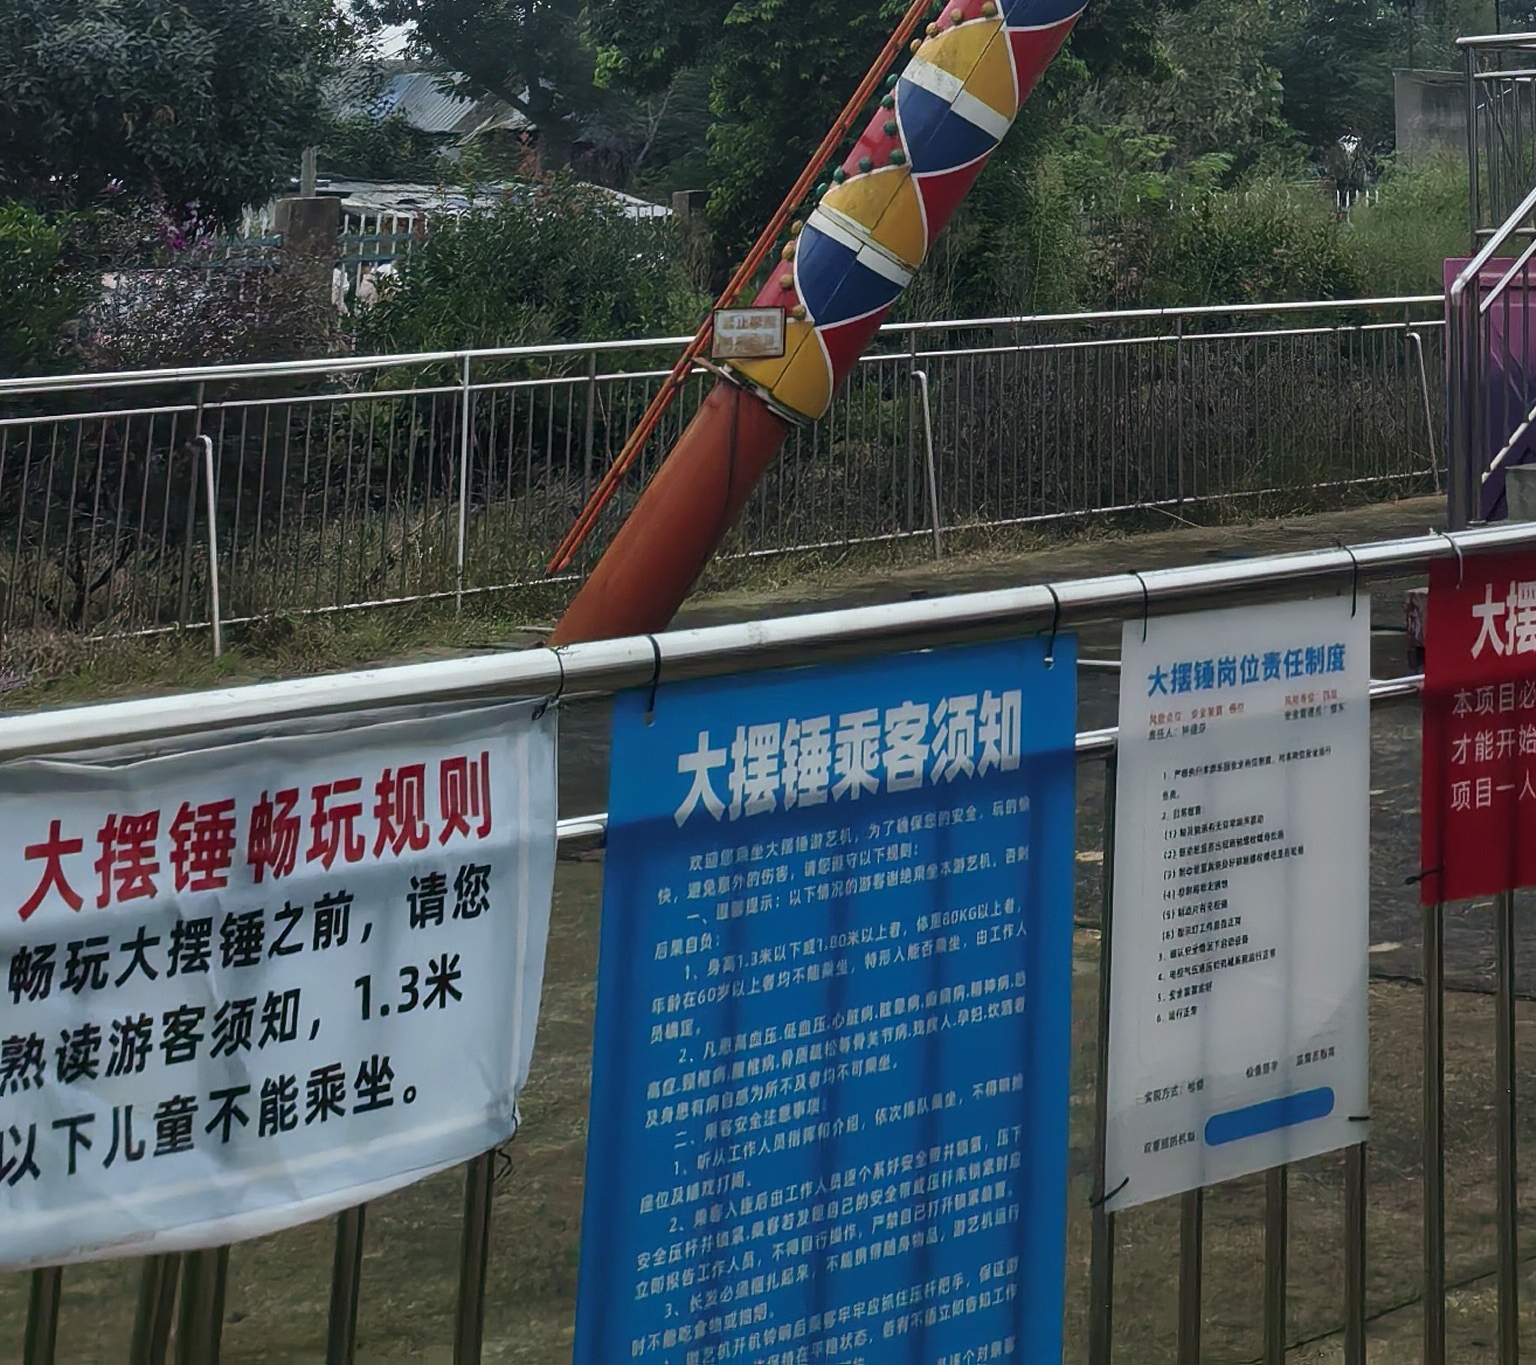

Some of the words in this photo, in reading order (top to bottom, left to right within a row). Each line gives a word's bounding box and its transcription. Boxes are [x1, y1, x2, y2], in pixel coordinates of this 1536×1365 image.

[1146, 642, 1347, 698] 大摆锤岗位责任制度
[673, 689, 1022, 830] 大摆锤乘客须知
[18, 751, 493, 923] 大摆锤畅玩规则
[7, 863, 493, 1005] 畅玩大摆锤之前，请您
[0, 954, 463, 1095] 熟读游客须知，1.3米
[0, 1054, 423, 1188] 以下儿童不能乘坐。
